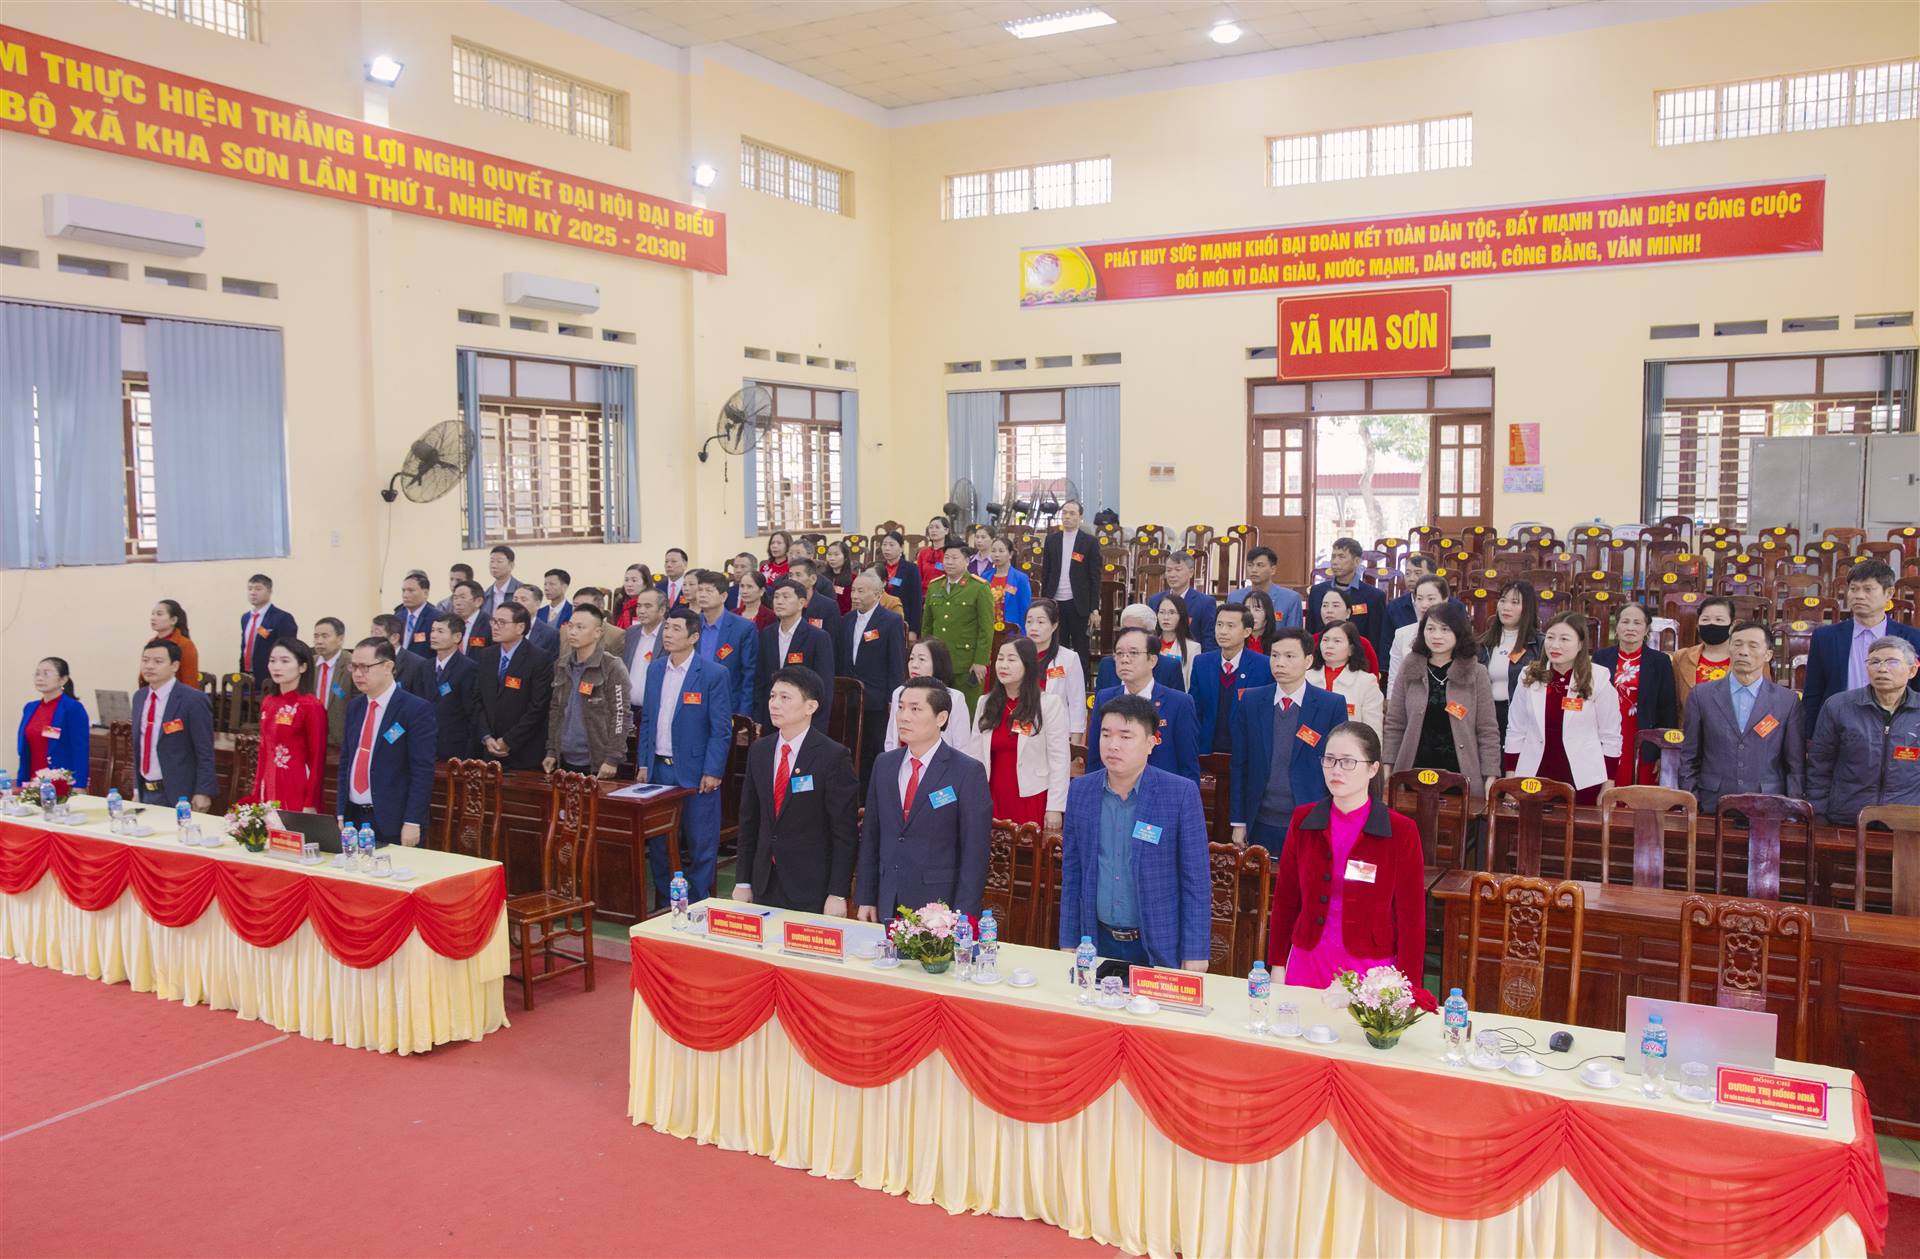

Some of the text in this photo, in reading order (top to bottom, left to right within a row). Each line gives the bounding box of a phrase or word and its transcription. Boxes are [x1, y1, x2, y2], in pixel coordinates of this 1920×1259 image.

[41, 51, 147, 105] THỰC
[159, 82, 243, 129] HIỆN
[251, 106, 355, 156] THẮNG
[363, 134, 406, 169] LỢI
[414, 146, 475, 190] NGHỊ
[483, 163, 553, 201] QUYẾT
[559, 183, 594, 212] ĐẠI
[601, 192, 633, 221] HỘI
[639, 202, 670, 231] ĐẠI
[675, 207, 715, 238] BIỂU
[0, 89, 57, 135] BỘ
[70, 108, 126, 146] XÃ
[136, 121, 211, 164] KHA
[221, 142, 290, 181] SƠN
[300, 157, 357, 195] LẦN
[365, 172, 422, 206] THỨ
[424, 184, 443, 215] I,
[449, 190, 528, 230] NHIỆM
[535, 209, 561, 238] KỲ
[568, 218, 618, 248] 2025
[636, 232, 687, 262] 2030!
[1104, 190, 1802, 269] PHÁT HUY SỨC MẠNH KHỐI ĐẠI ĐOÀN KẾT TOÀN DÂN TỘC, ĐẨY MẠNH TOÀN DIỆN CÔNG CUỘC
[1176, 232, 1701, 290] ĐỔI MỚI VÌ DÂN GIÀU, NƯỚC MẠNH, DÂN CHỦ, CÔNG BẰNG, VĂN MINH!
[1290, 309, 1438, 356] XÃ KHA SƠN
[1669, 731, 1681, 741] 134
[1422, 771, 1436, 782] 112
[1525, 780, 1538, 791] 107
